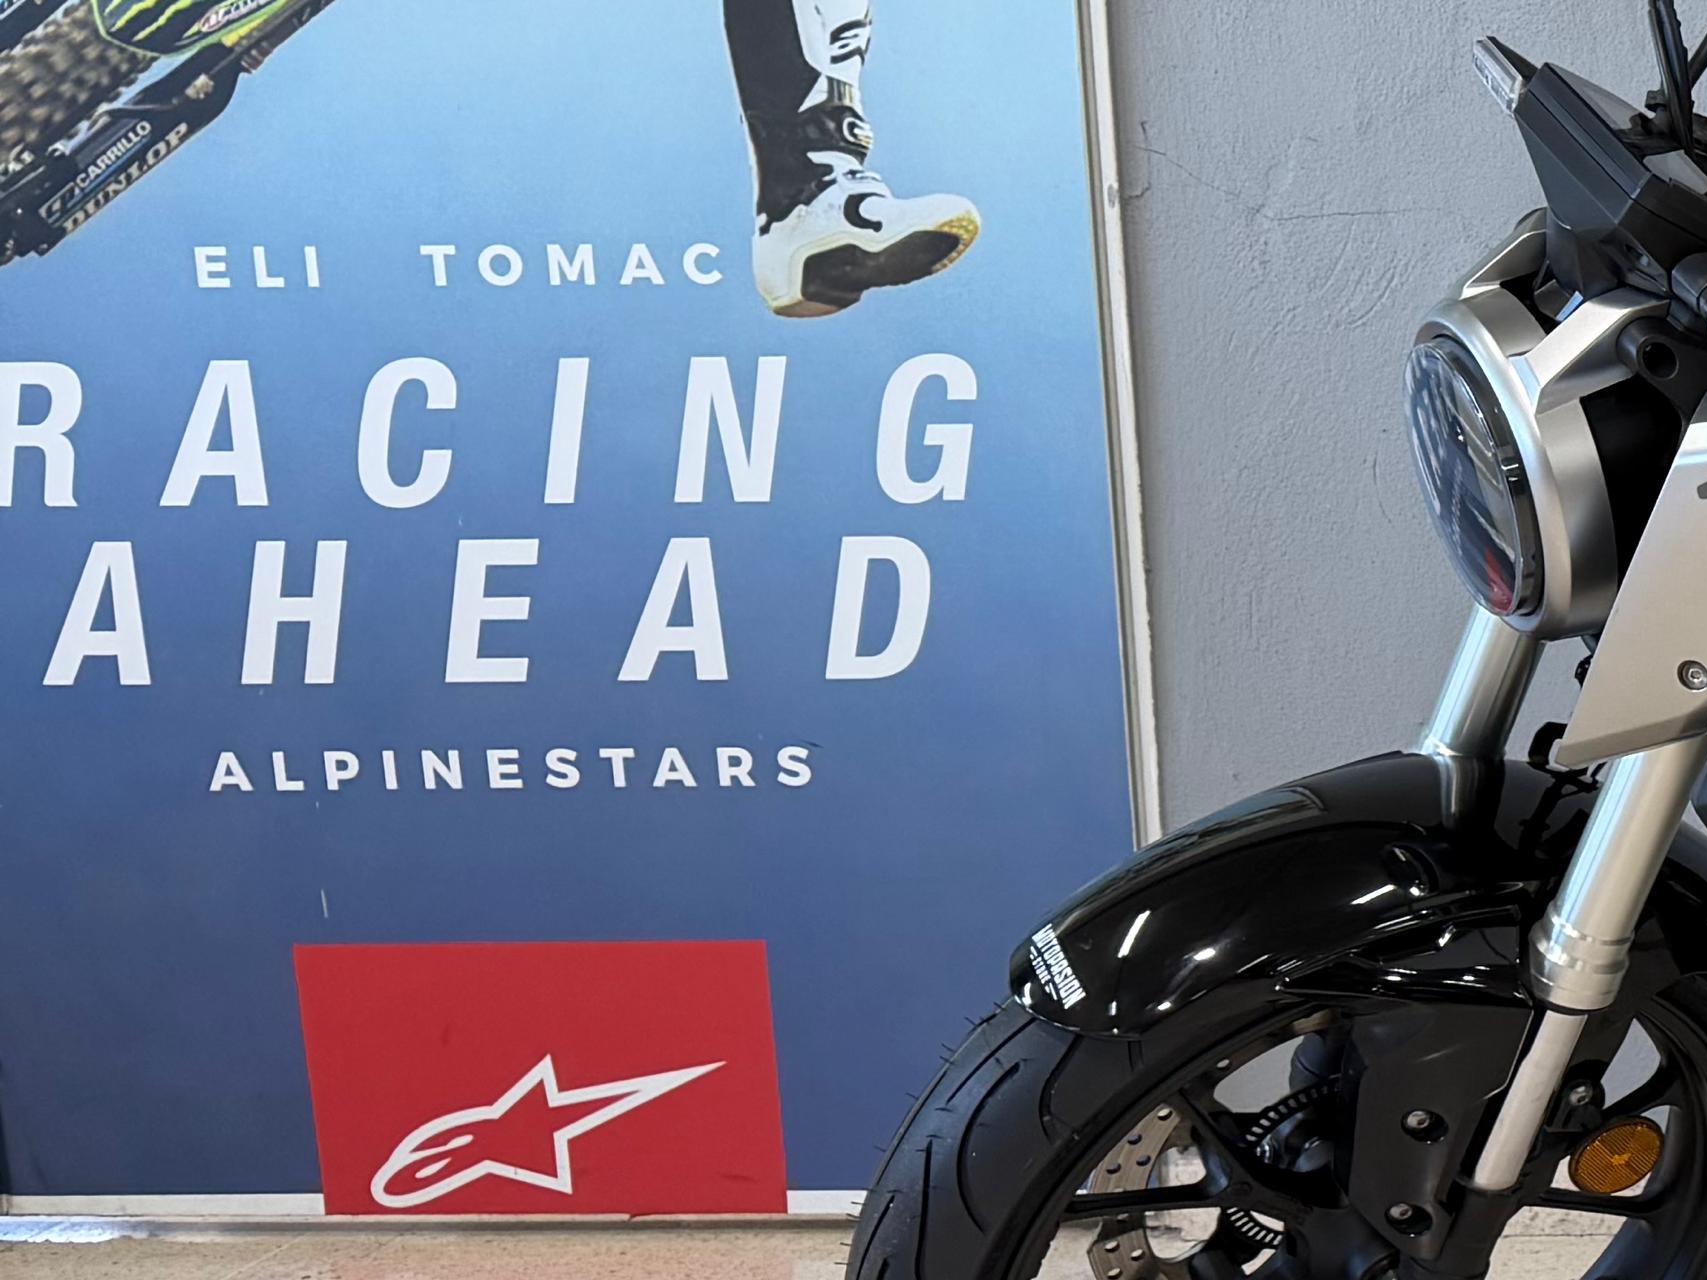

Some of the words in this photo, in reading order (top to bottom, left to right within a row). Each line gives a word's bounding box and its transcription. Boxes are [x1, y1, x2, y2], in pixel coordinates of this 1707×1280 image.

[62, 122, 189, 234] DUNLOP
[76, 120, 152, 188] CARRILLO
[194, 245, 321, 288] ELI
[420, 242, 724, 287] TOMAC
[0, 353, 978, 508] RACING
[43, 536, 932, 686] AHEAD
[210, 746, 813, 791] ALPINESTARS
